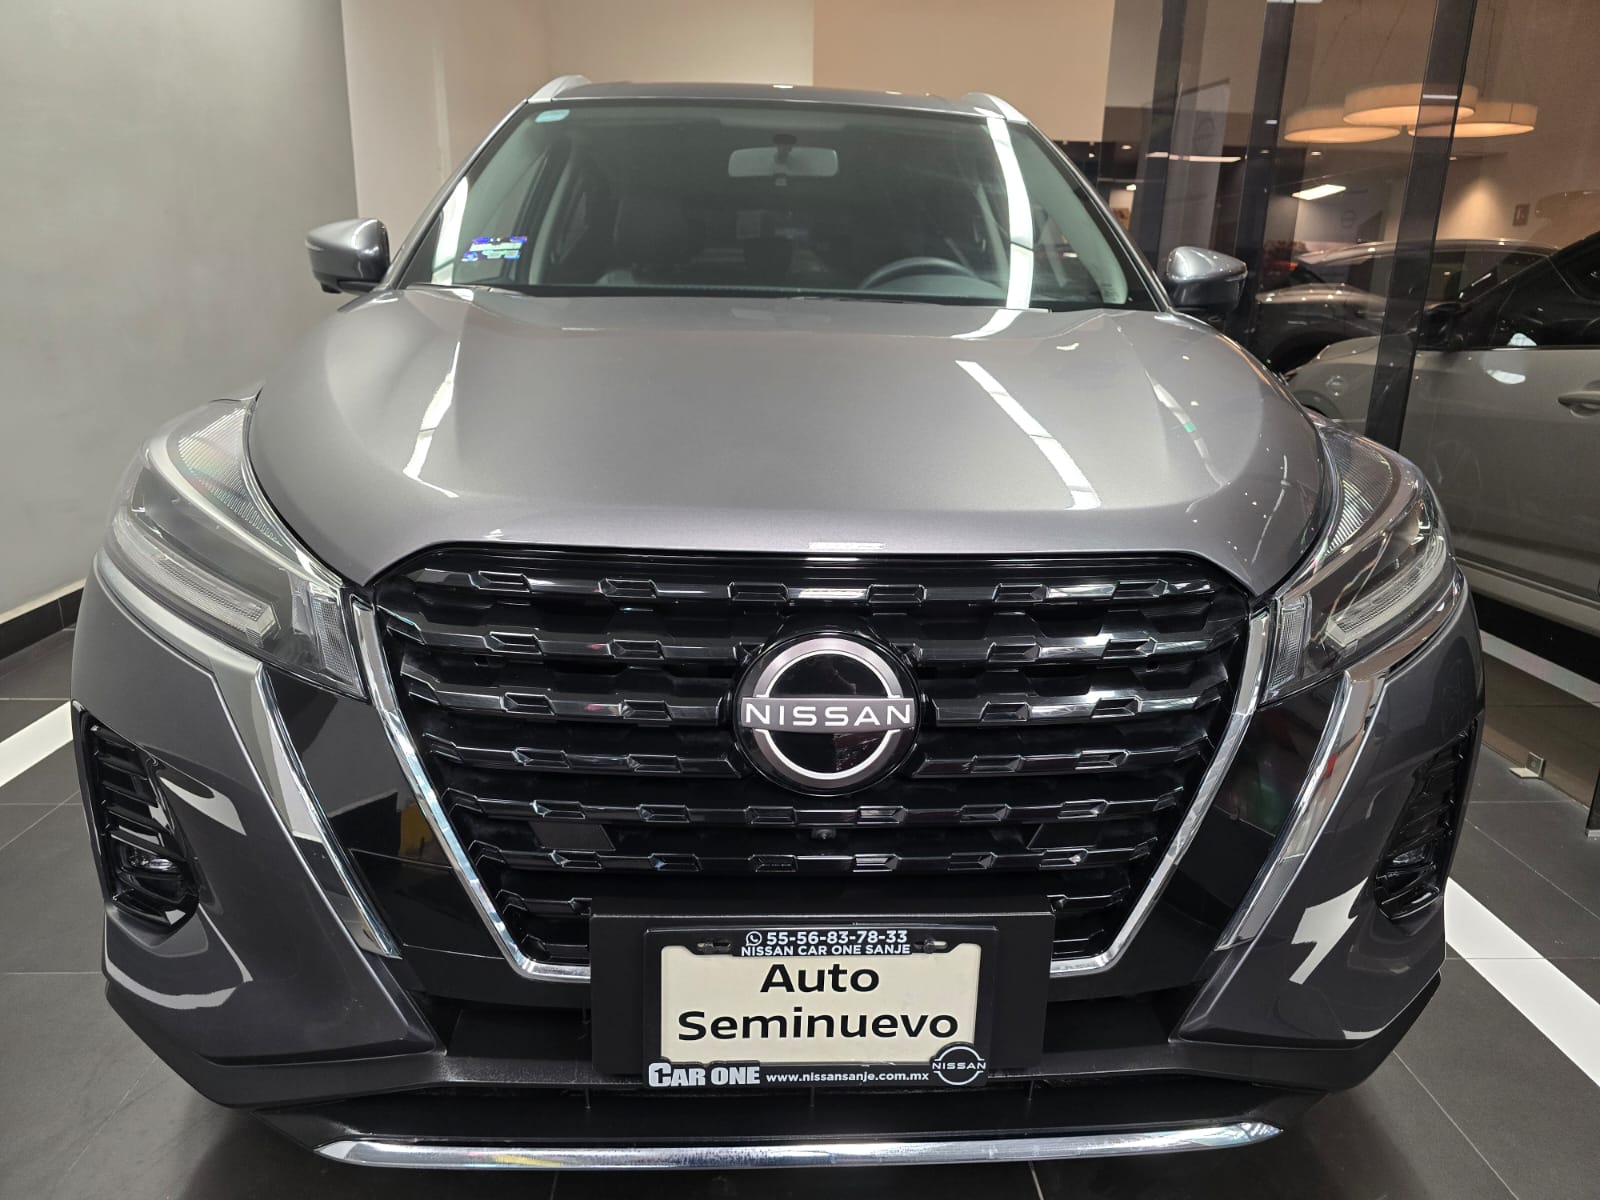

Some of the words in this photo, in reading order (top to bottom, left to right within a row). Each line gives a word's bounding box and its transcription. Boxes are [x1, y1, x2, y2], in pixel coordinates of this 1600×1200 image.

[745, 703, 911, 727] NISSAN
[766, 930, 908, 945] 55-56-83-78-33
[741, 945, 794, 957] NISSAN
[797, 945, 828, 956] CAR
[831, 944, 862, 955] ONE
[865, 944, 911, 955] SANJE
[760, 963, 880, 993] Auto
[678, 1006, 959, 1041] Seminuevo
[648, 1062, 706, 1087] CAR
[710, 1066, 761, 1086] ONE
[932, 1062, 987, 1070] NISSAN
[766, 1071, 929, 1083] www.nissansanje.com.mx
